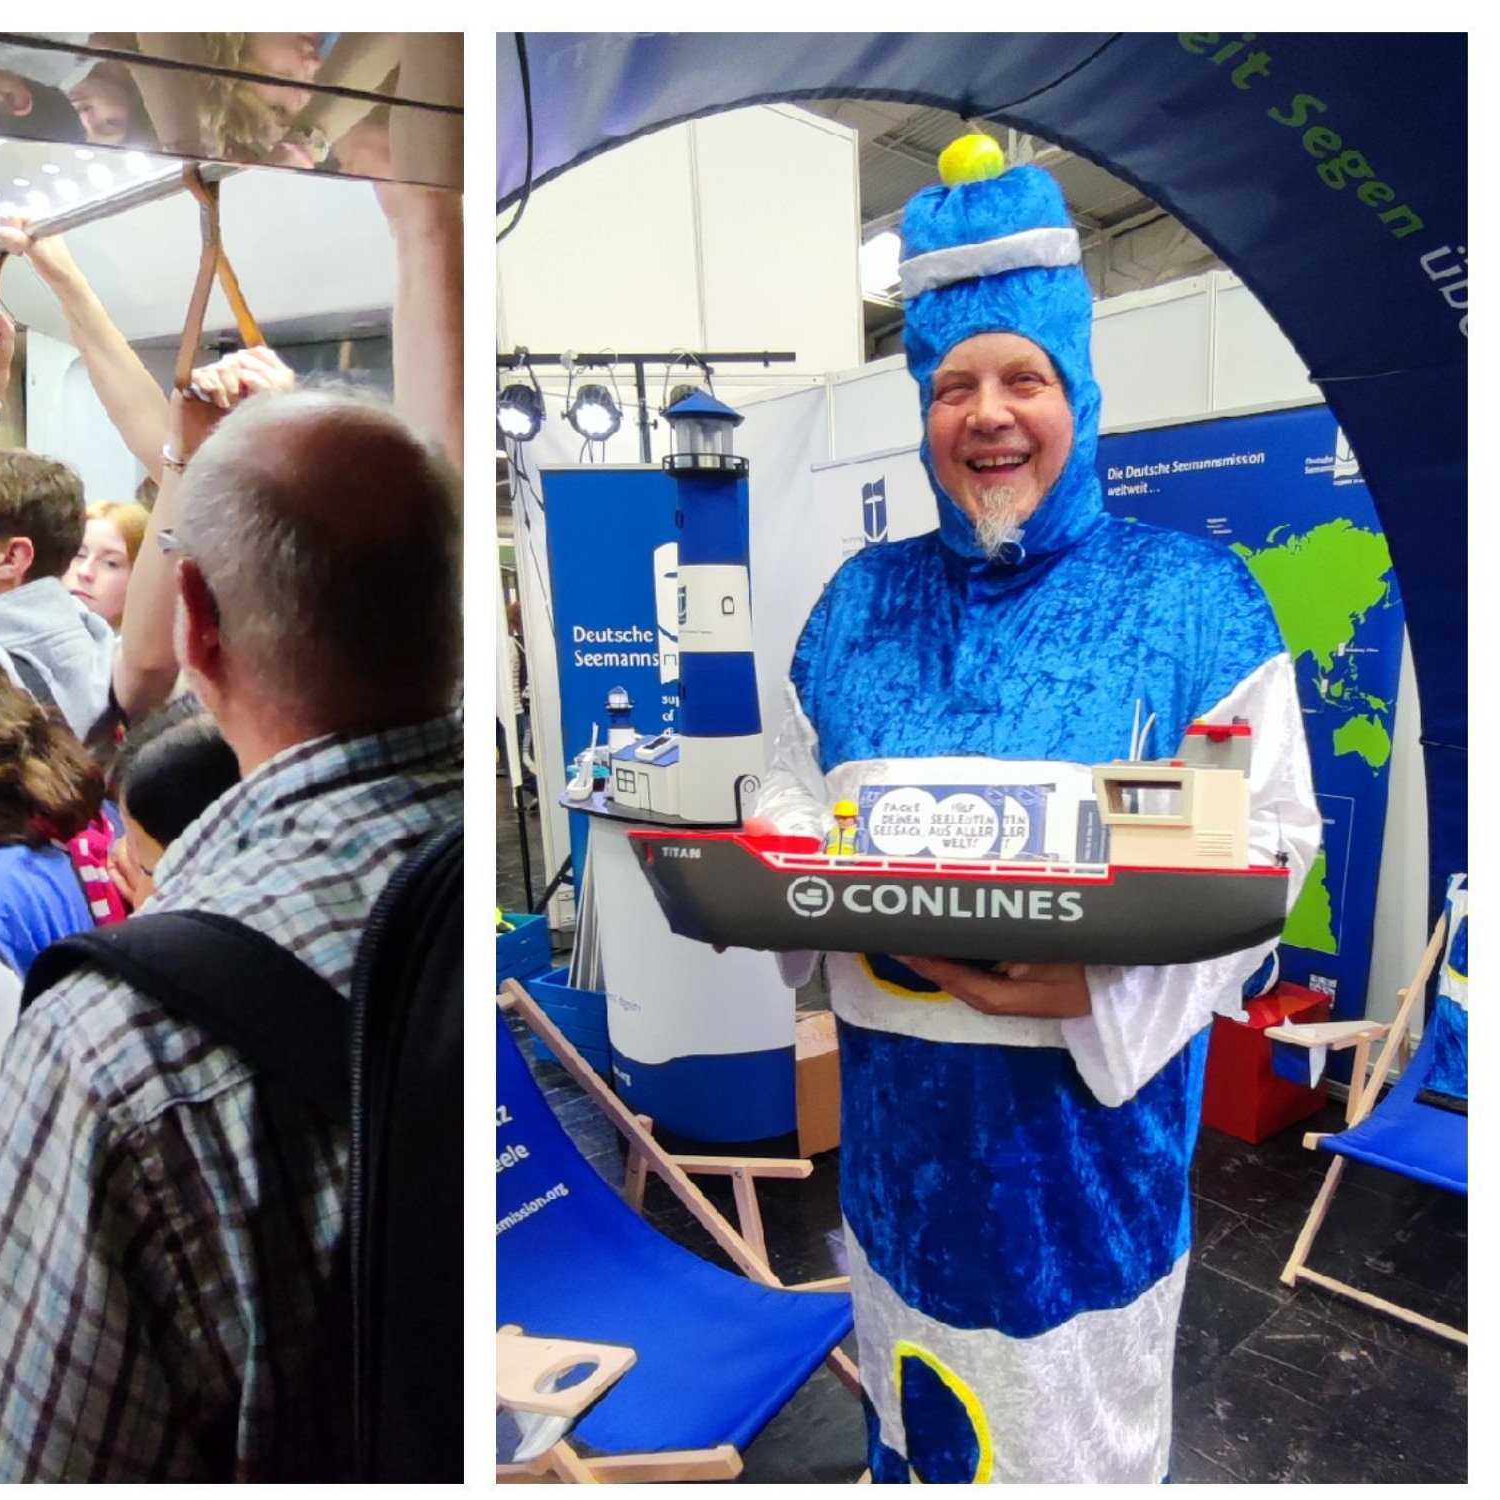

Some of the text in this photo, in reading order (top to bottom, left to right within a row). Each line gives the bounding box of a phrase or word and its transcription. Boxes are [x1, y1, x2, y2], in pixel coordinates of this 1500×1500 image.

[1266, 93, 1424, 238] Segen
[1108, 452, 1265, 480] Die Deutsche Seemannsmission
[1108, 482, 1148, 497] weltweit
[574, 625, 654, 643] Deutsche
[955, 827, 994, 838] ALLER
[662, 846, 701, 859] TITAN
[841, 883, 1084, 923] CONLINES
